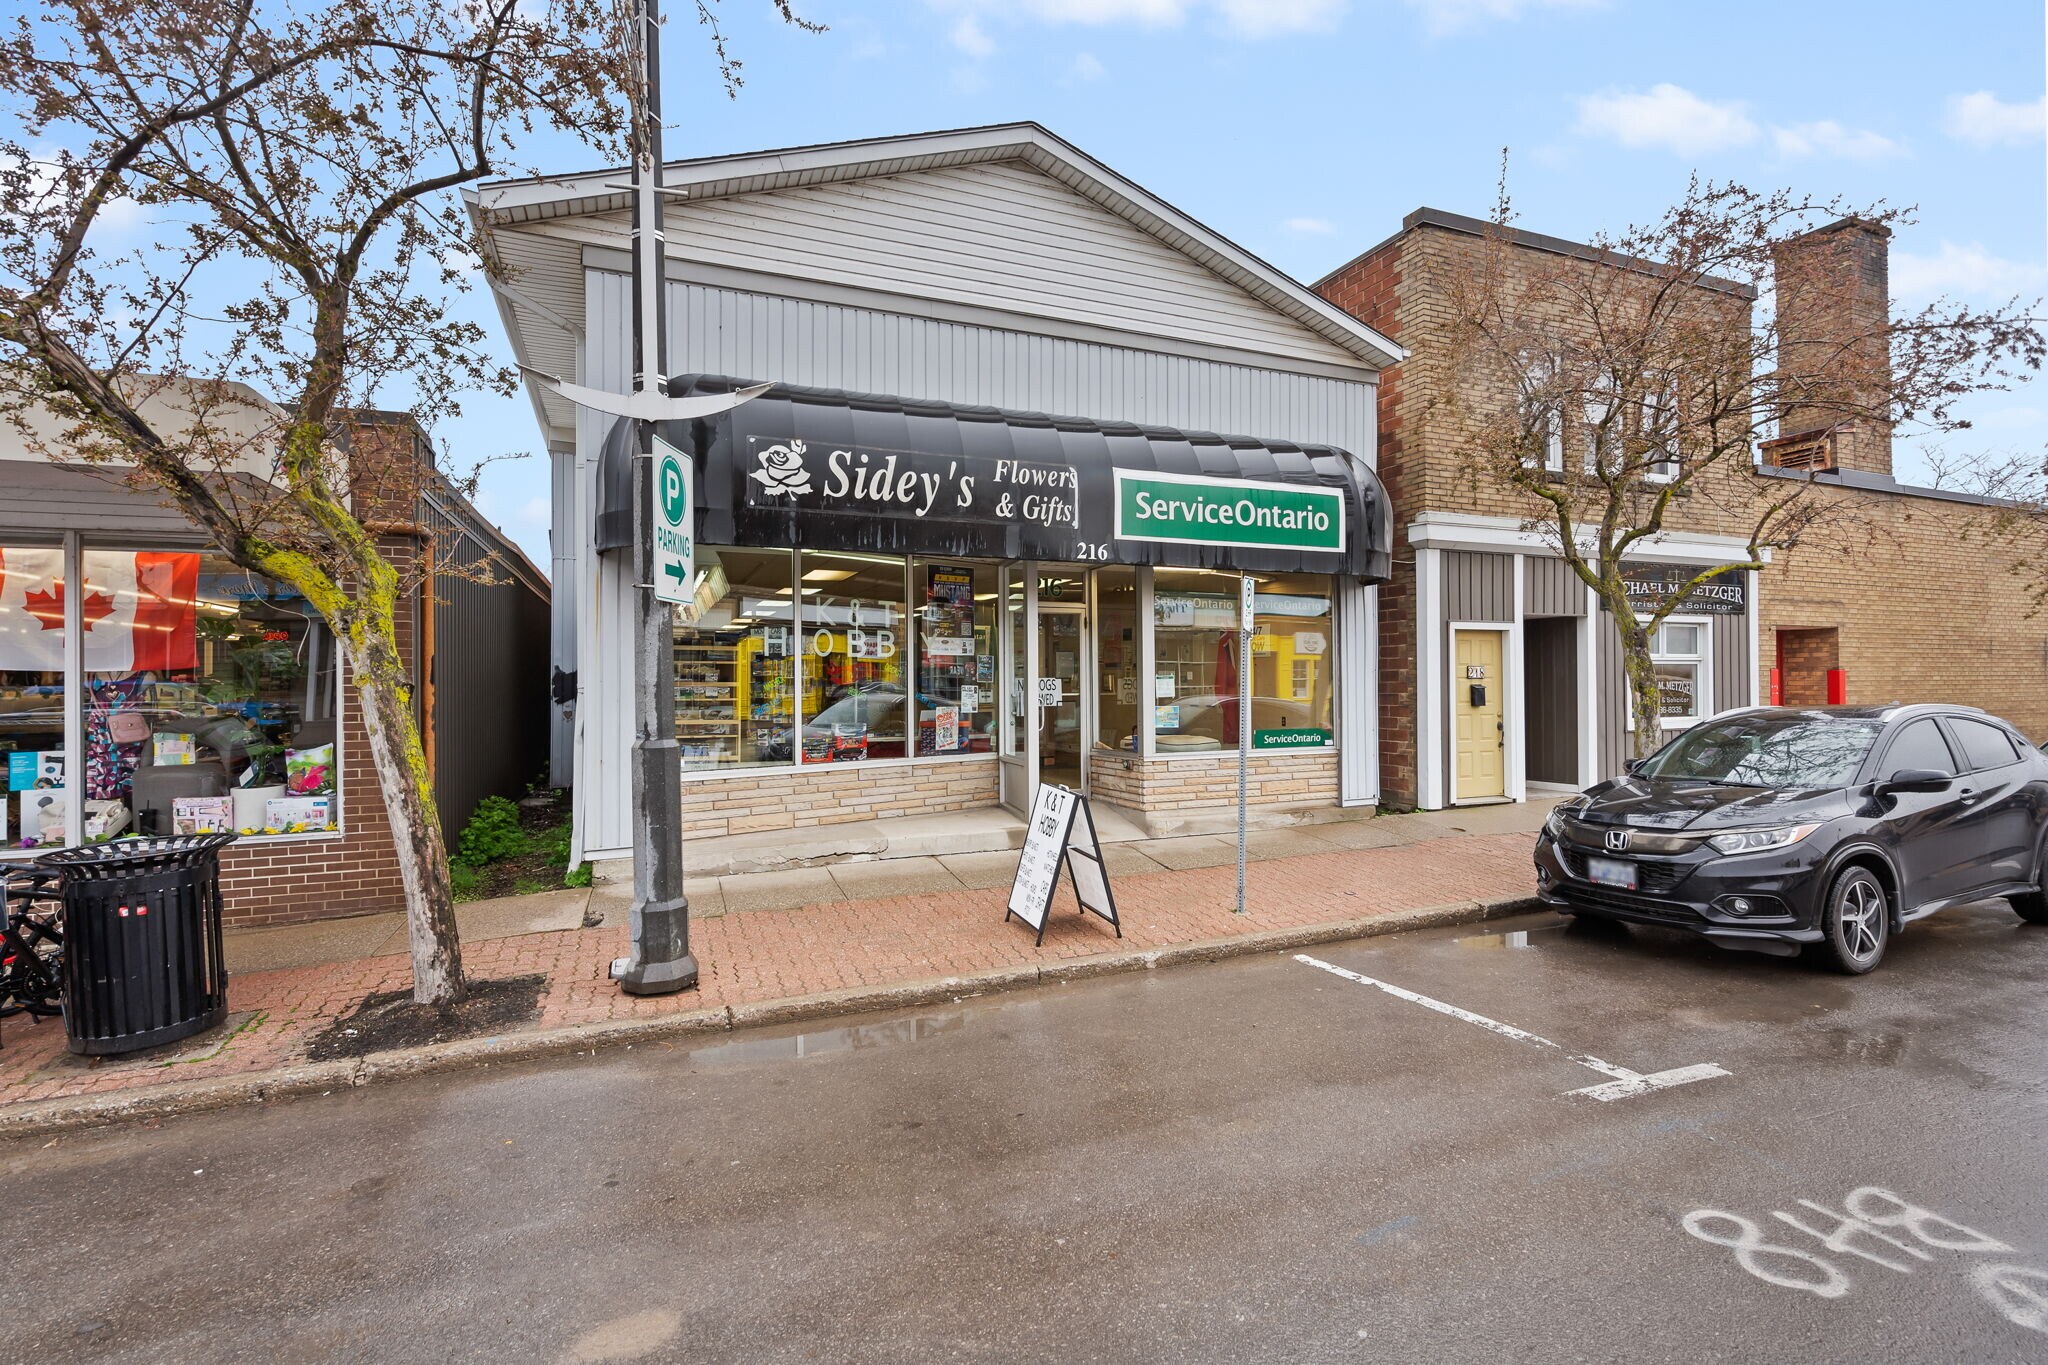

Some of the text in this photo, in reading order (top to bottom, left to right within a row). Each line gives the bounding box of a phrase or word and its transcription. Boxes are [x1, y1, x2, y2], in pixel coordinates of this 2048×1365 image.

[823, 449, 976, 517] Sidey's
[993, 459, 1077, 490] Flowers
[666, 468, 680, 511] P
[995, 492, 1073, 528] & Gifts
[1135, 491, 1329, 532] ServiceOntario
[658, 526, 691, 559] PARKING
[1076, 542, 1108, 562] 216
[1254, 599, 1322, 611] erviceOntario
[1622, 580, 1744, 605] CHAEL M ETZGER
[1686, 602, 1733, 610] Solicitor
[1038, 679, 1057, 691] OGS
[1263, 734, 1322, 745] ServiceOntario
[1044, 789, 1053, 810] K
[1038, 813, 1060, 839] HOBBY
